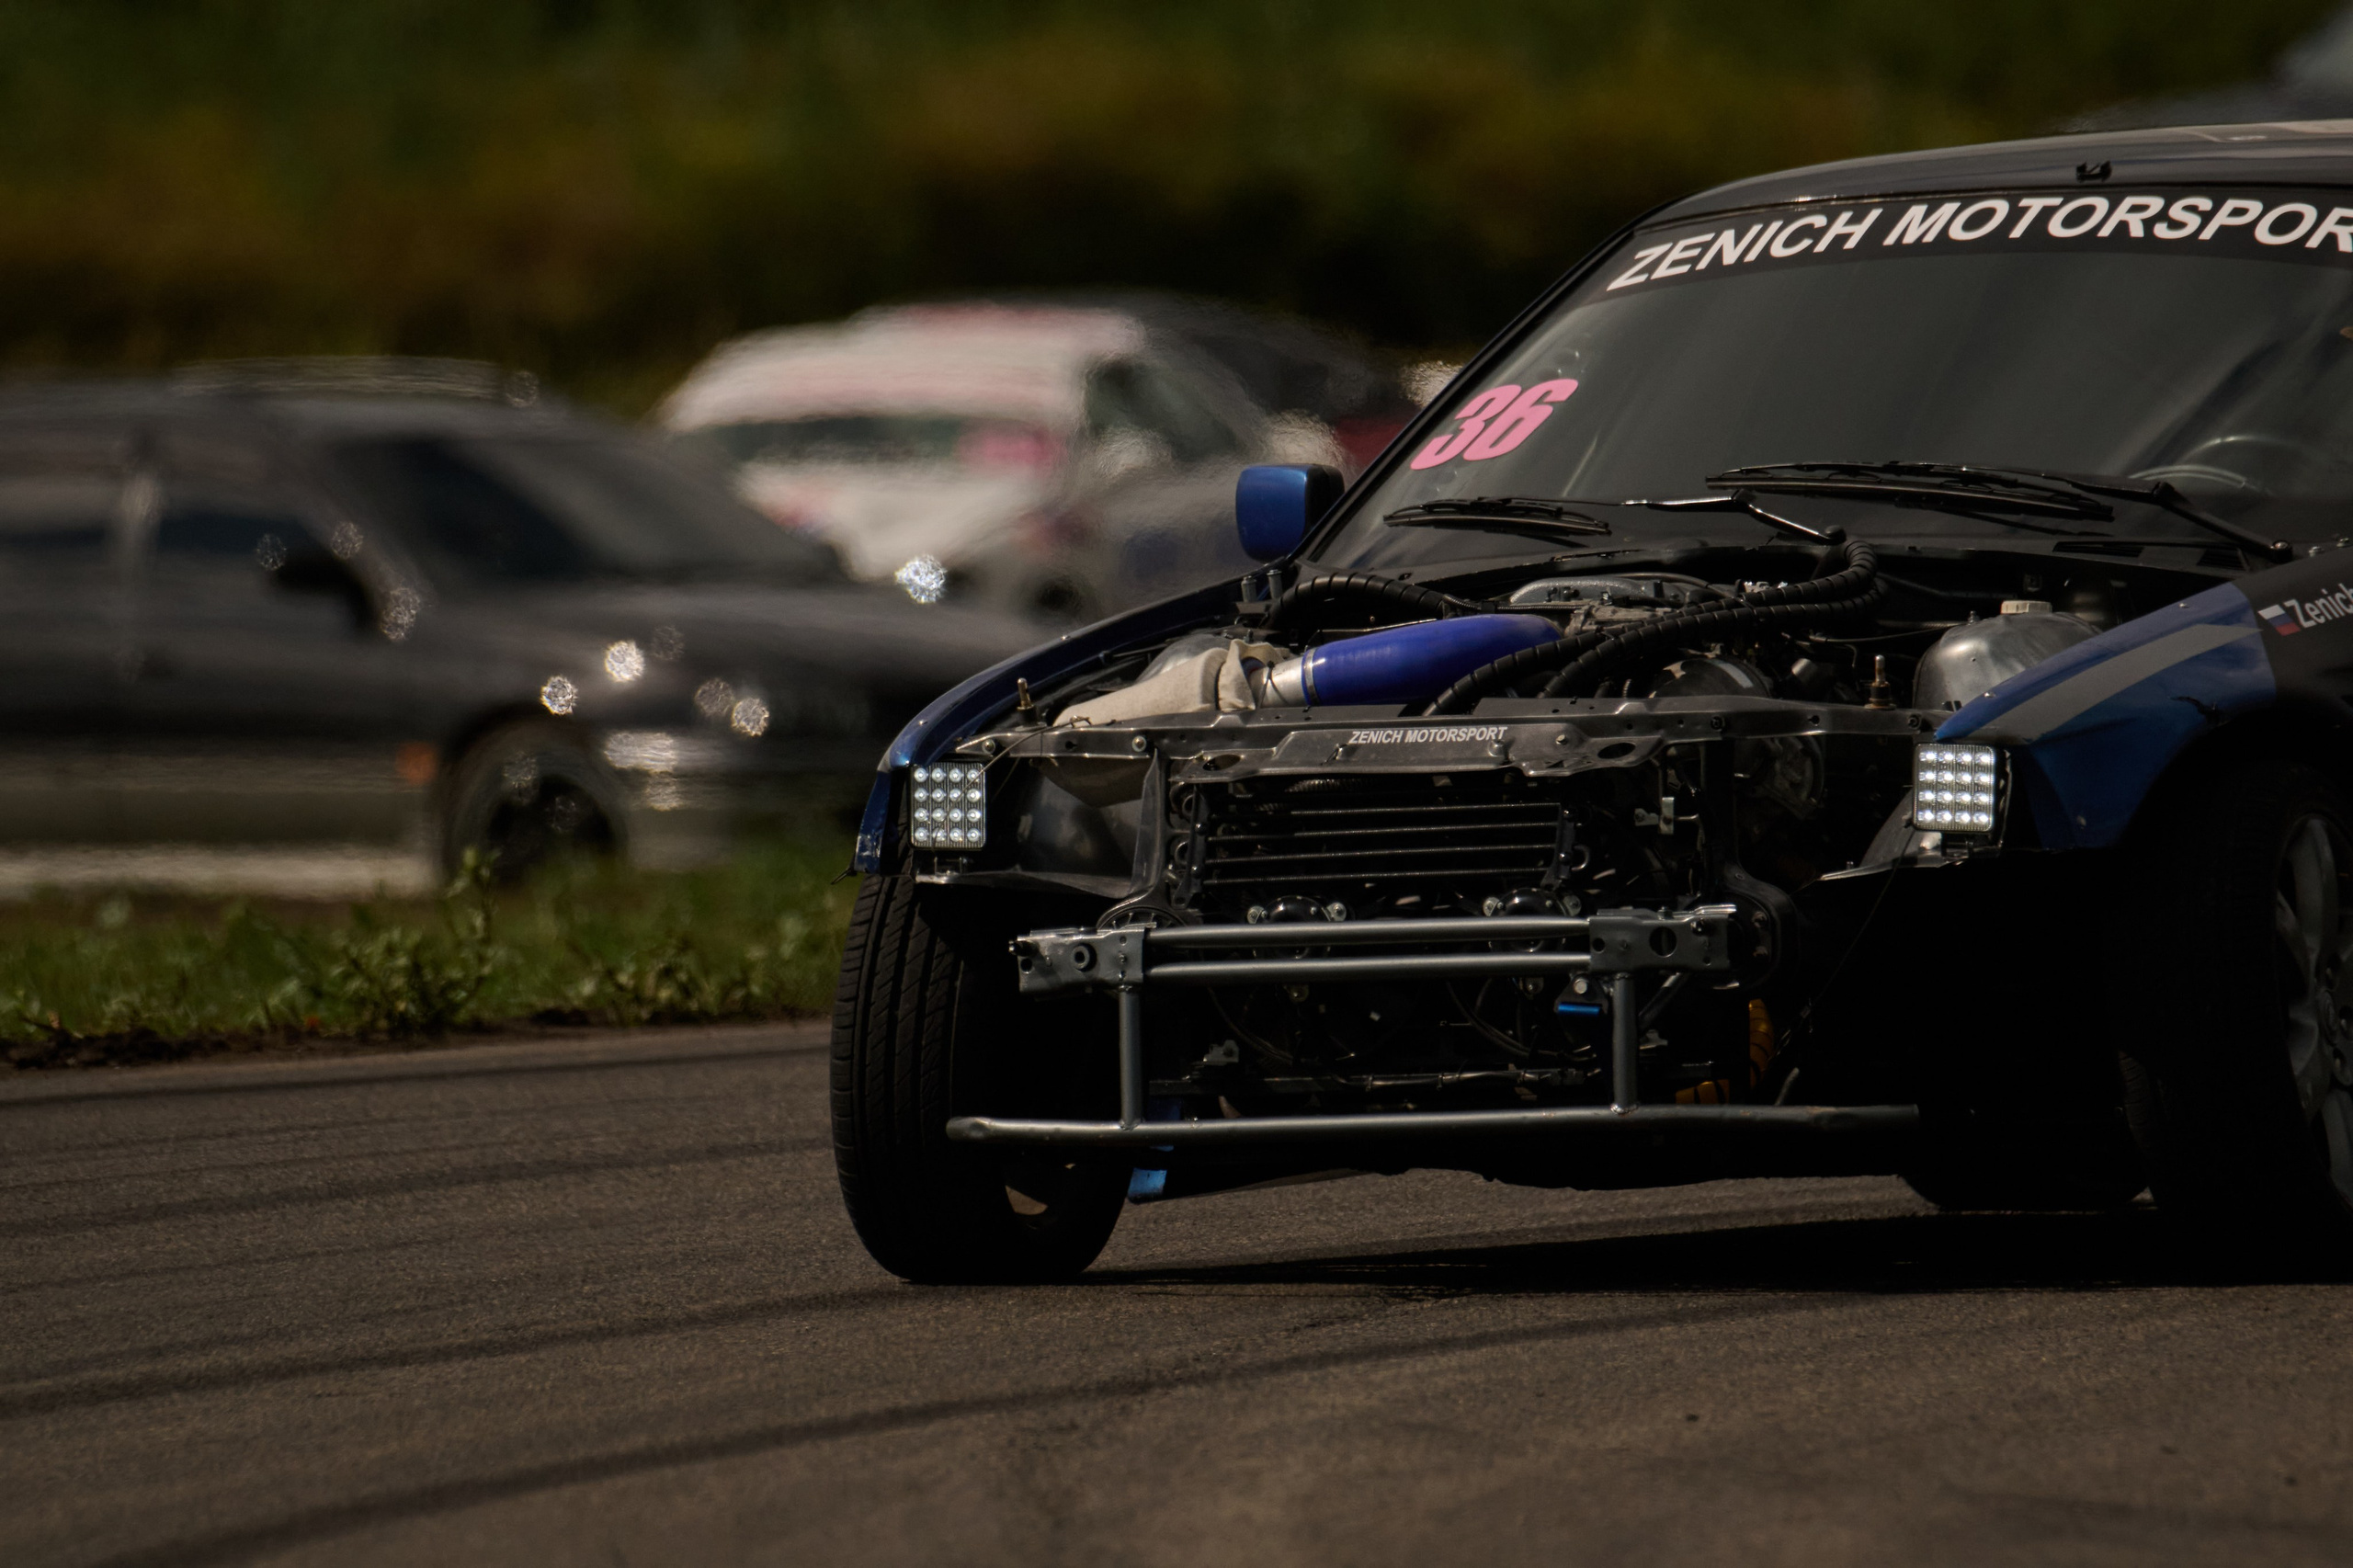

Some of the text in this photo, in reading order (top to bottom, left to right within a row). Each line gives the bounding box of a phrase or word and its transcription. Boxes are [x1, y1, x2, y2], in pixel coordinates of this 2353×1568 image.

[1607, 207, 1883, 291] ZENICH
[1410, 378, 1579, 470] 36
[1348, 726, 1507, 744] ZENICH MOTORSPORT
